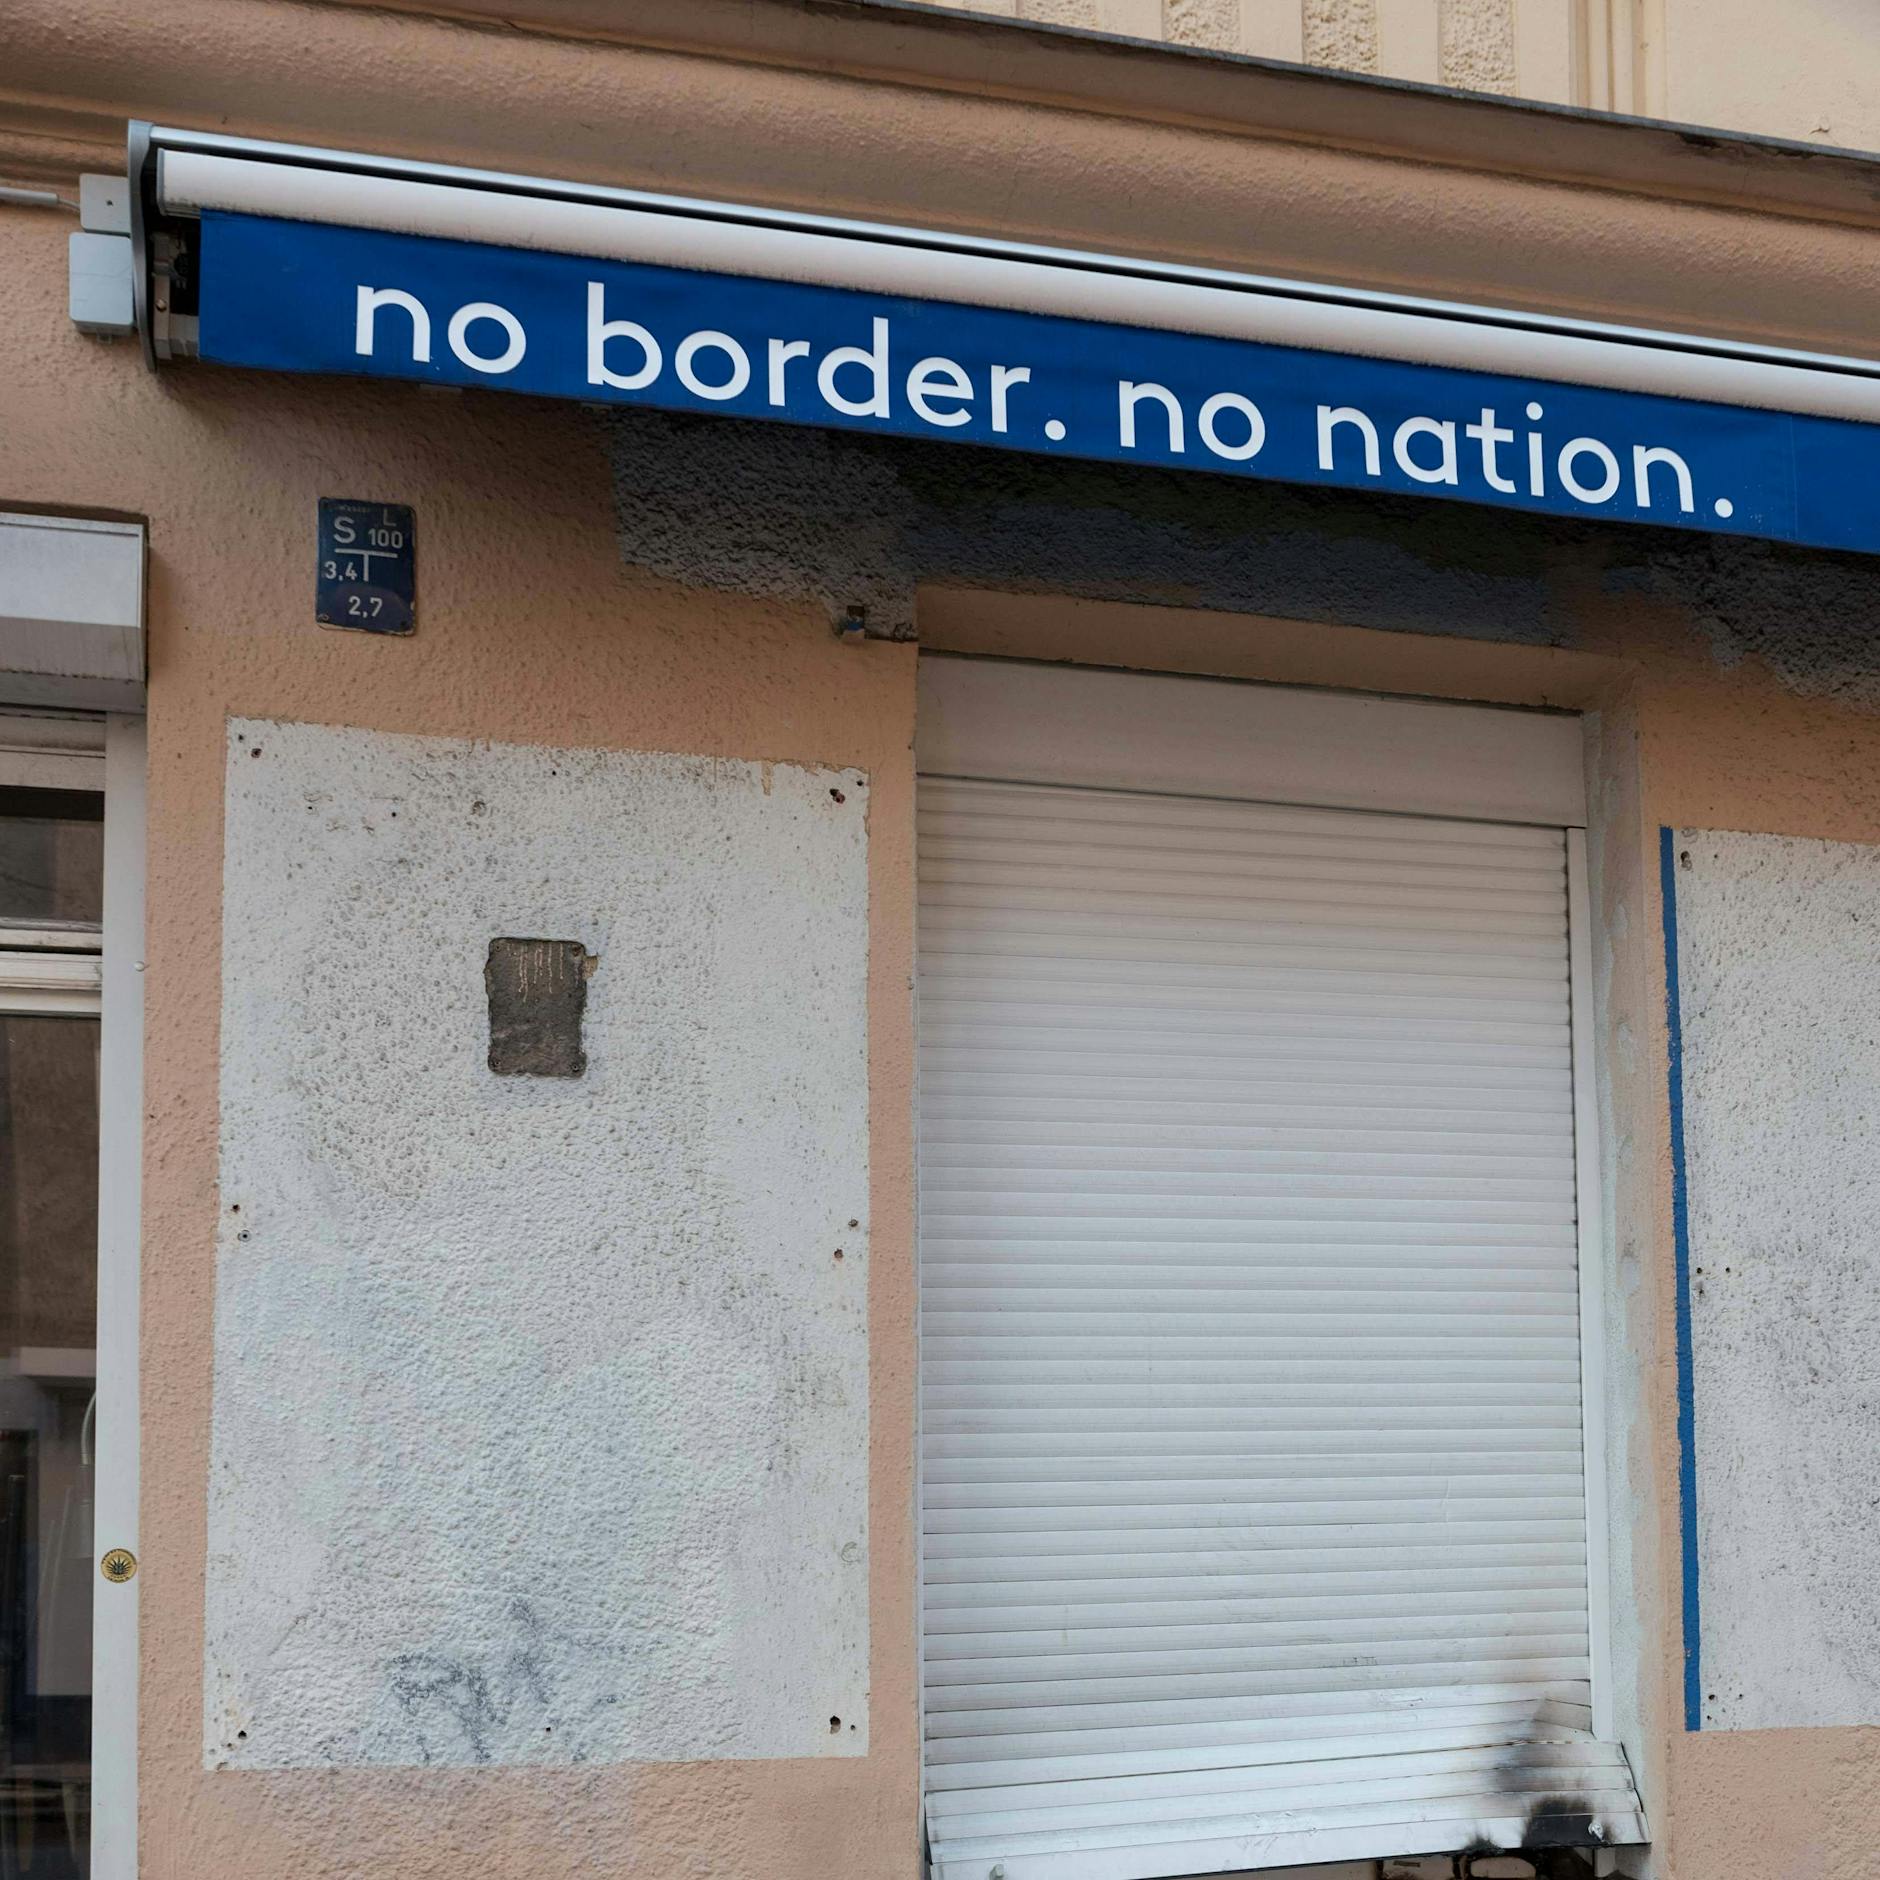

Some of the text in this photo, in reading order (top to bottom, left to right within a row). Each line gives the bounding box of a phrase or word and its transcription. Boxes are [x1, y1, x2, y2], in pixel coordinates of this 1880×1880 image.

[355, 281, 1734, 518] no border. no nation.
[382, 508, 396, 527] L
[333, 515, 404, 549] S 100
[348, 595, 383, 618] 2,7
